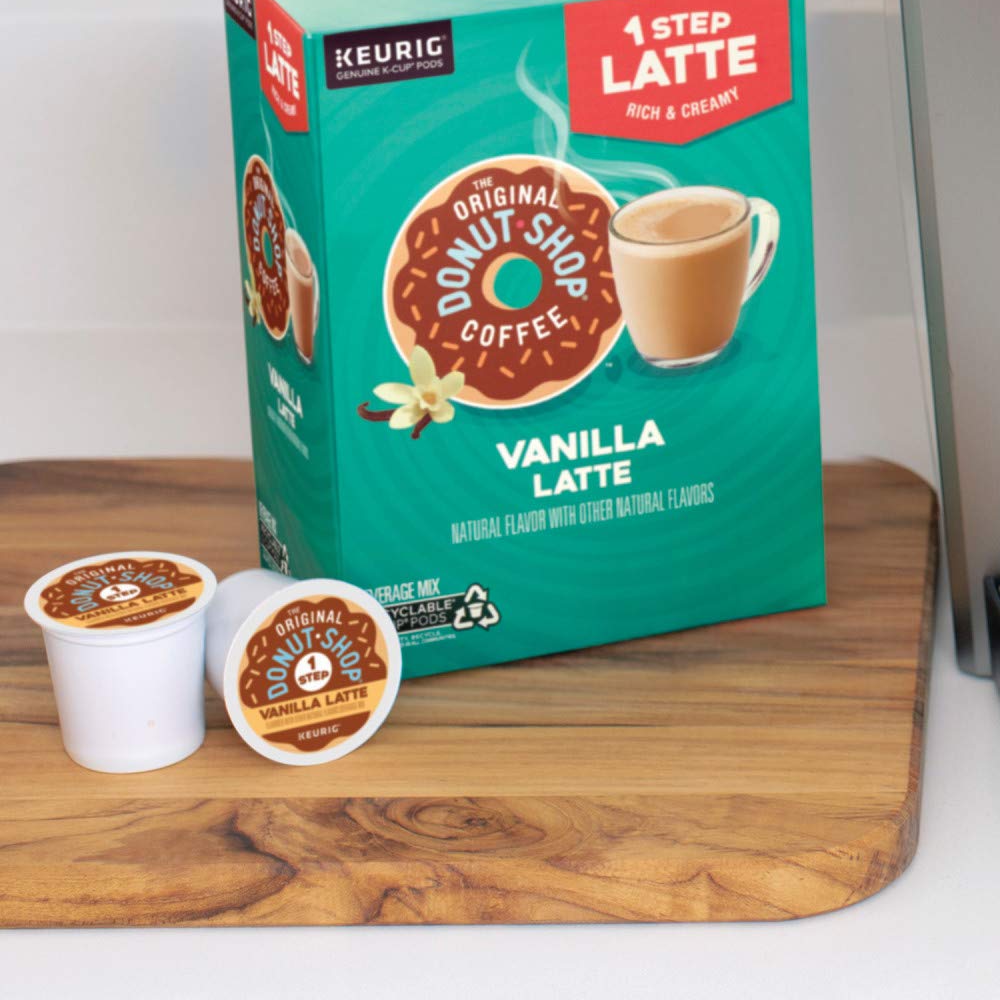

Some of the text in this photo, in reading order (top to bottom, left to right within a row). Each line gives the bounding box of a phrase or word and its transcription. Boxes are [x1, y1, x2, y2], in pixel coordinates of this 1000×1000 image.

[623, 12, 731, 46] 1 STEP
[335, 36, 443, 68] KEURIG
[601, 34, 757, 95] LATTE
[263, 41, 300, 101] LATTE
[336, 67, 380, 80] GENUINE
[417, 59, 443, 70] PODS
[626, 86, 740, 121] RICH & CREAMY
[472, 177, 493, 191] THE
[453, 185, 560, 220] ORIGINAL
[436, 209, 587, 317] DONUT SHOP
[461, 305, 568, 348] COFFEE
[496, 419, 665, 470] VANILLA
[533, 460, 632, 498] LATTE
[451, 482, 715, 544] NATURAL FLAVOR WITH OTHER NATURAL FLAVORS
[66, 563, 136, 586] ORIGINAL
[417, 578, 441, 598] MIX
[70, 573, 111, 612] DONUT
[119, 571, 175, 590] SHOP
[75, 601, 139, 622] VANILLA
[143, 587, 188, 604] LATTE
[106, 588, 139, 600] STEP
[275, 610, 342, 637] ORIGINAL
[287, 606, 300, 616] THE
[410, 612, 447, 628] PODS
[266, 626, 362, 700] DONUT SHOP
[298, 671, 329, 685] STEP
[307, 656, 316, 671] 1
[259, 698, 321, 720] VANILLA
[325, 687, 368, 706] LATTE
[298, 725, 339, 741] KEURIG
